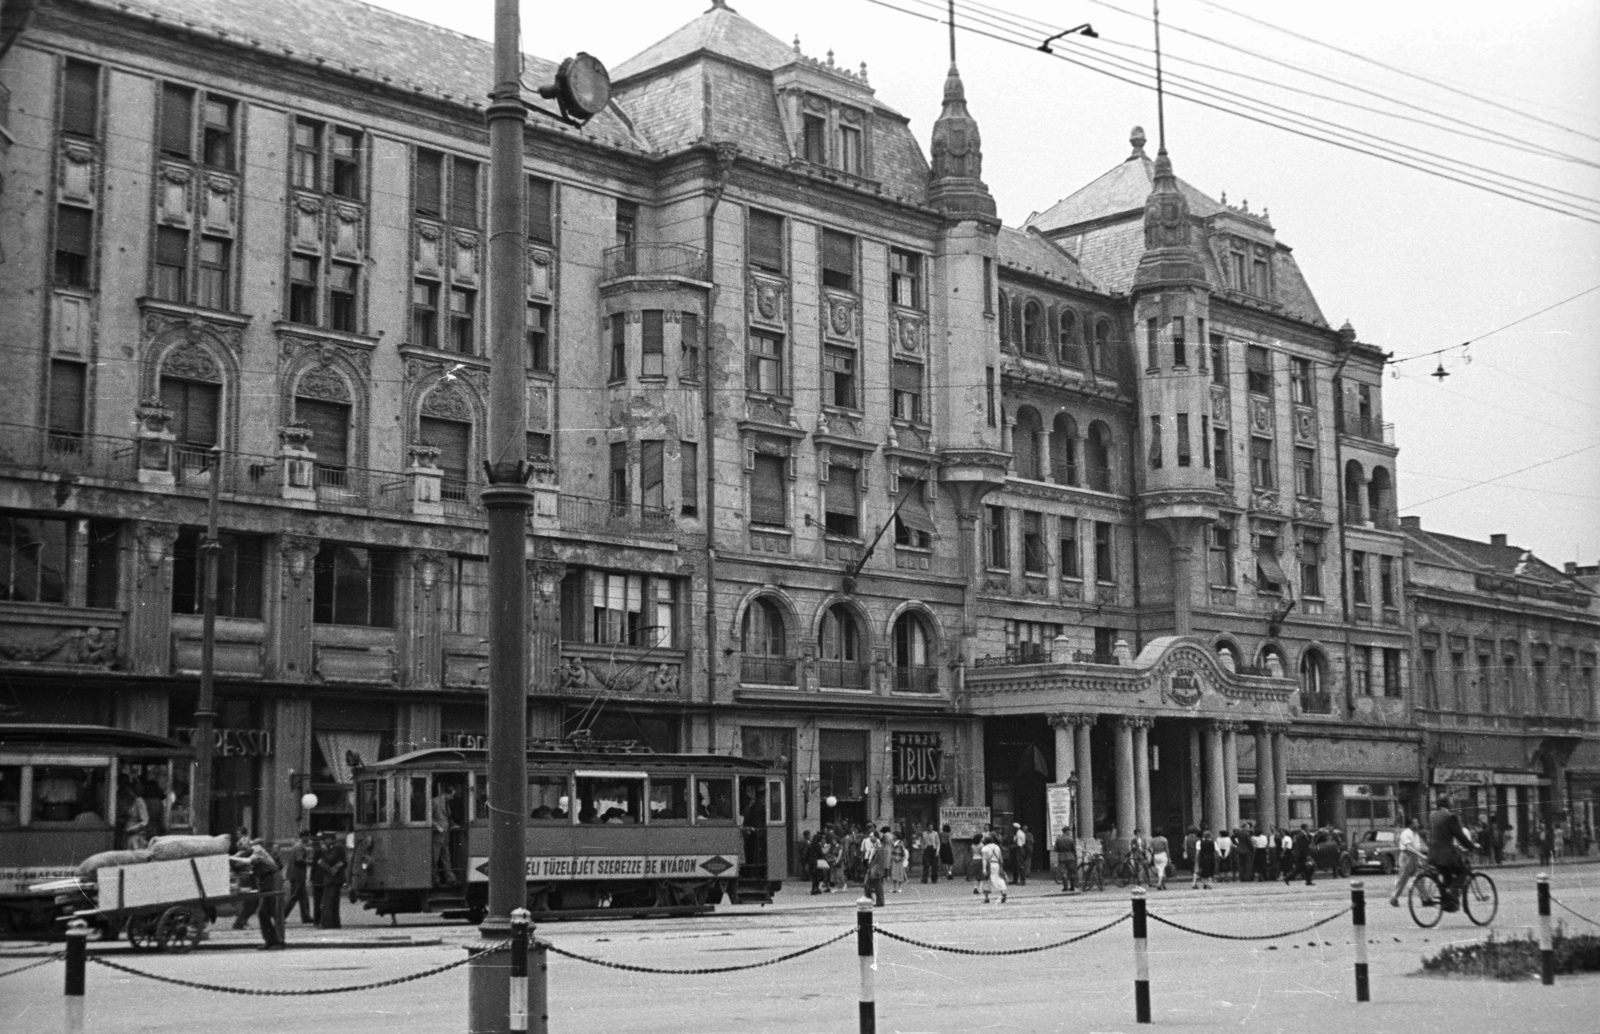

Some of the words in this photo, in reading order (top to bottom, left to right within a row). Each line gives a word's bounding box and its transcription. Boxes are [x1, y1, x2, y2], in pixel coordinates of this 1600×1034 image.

[526, 857, 540, 877] ÉLI
[597, 859, 642, 875] SZEREZZE
[645, 859, 658, 875] BE
